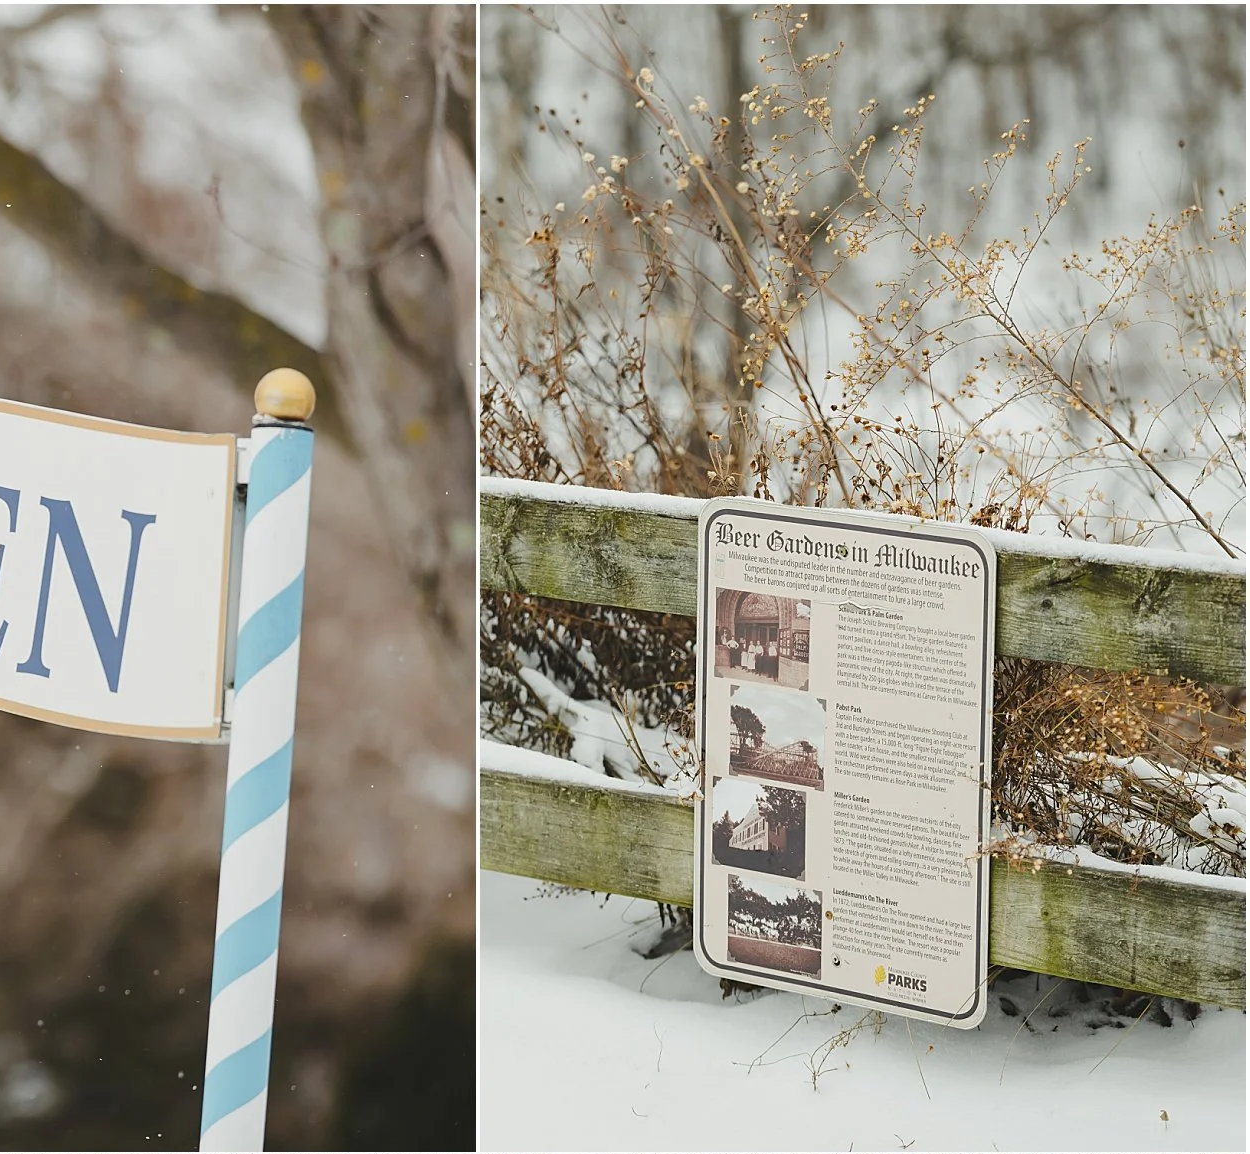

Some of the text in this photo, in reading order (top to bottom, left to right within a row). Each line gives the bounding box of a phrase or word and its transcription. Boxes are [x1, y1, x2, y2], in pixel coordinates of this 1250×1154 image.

[715, 522, 980, 578] Beer Gardens in Milwaukee
[770, 557, 779, 566] the
[811, 562, 829, 572] leader
[836, 566, 846, 575] the
[846, 567, 868, 578] number
[869, 570, 880, 579] and
[924, 577, 938, 586] beer
[744, 574, 754, 584] The
[754, 576, 767, 585] beer
[767, 578, 786, 588] barons
[786, 580, 810, 594] conjured
[827, 585, 841, 595] sorts
[895, 594, 906, 604] lure
[911, 597, 926, 609] large
[785, 569, 803, 580] attract
[804, 572, 825, 585] patrons
[825, 575, 850, 586] between
[850, 578, 860, 587] the
[860, 579, 880, 590] dozens
[887, 583, 910, 596] gardens
[885, 611, 904, 621] Garden
[836, 703, 862, 713] Pabst Park
[834, 791, 870, 804] Miller's Garden
[876, 896, 885, 905] The
[885, 898, 898, 907] River
[888, 973, 927, 992] PARKS
